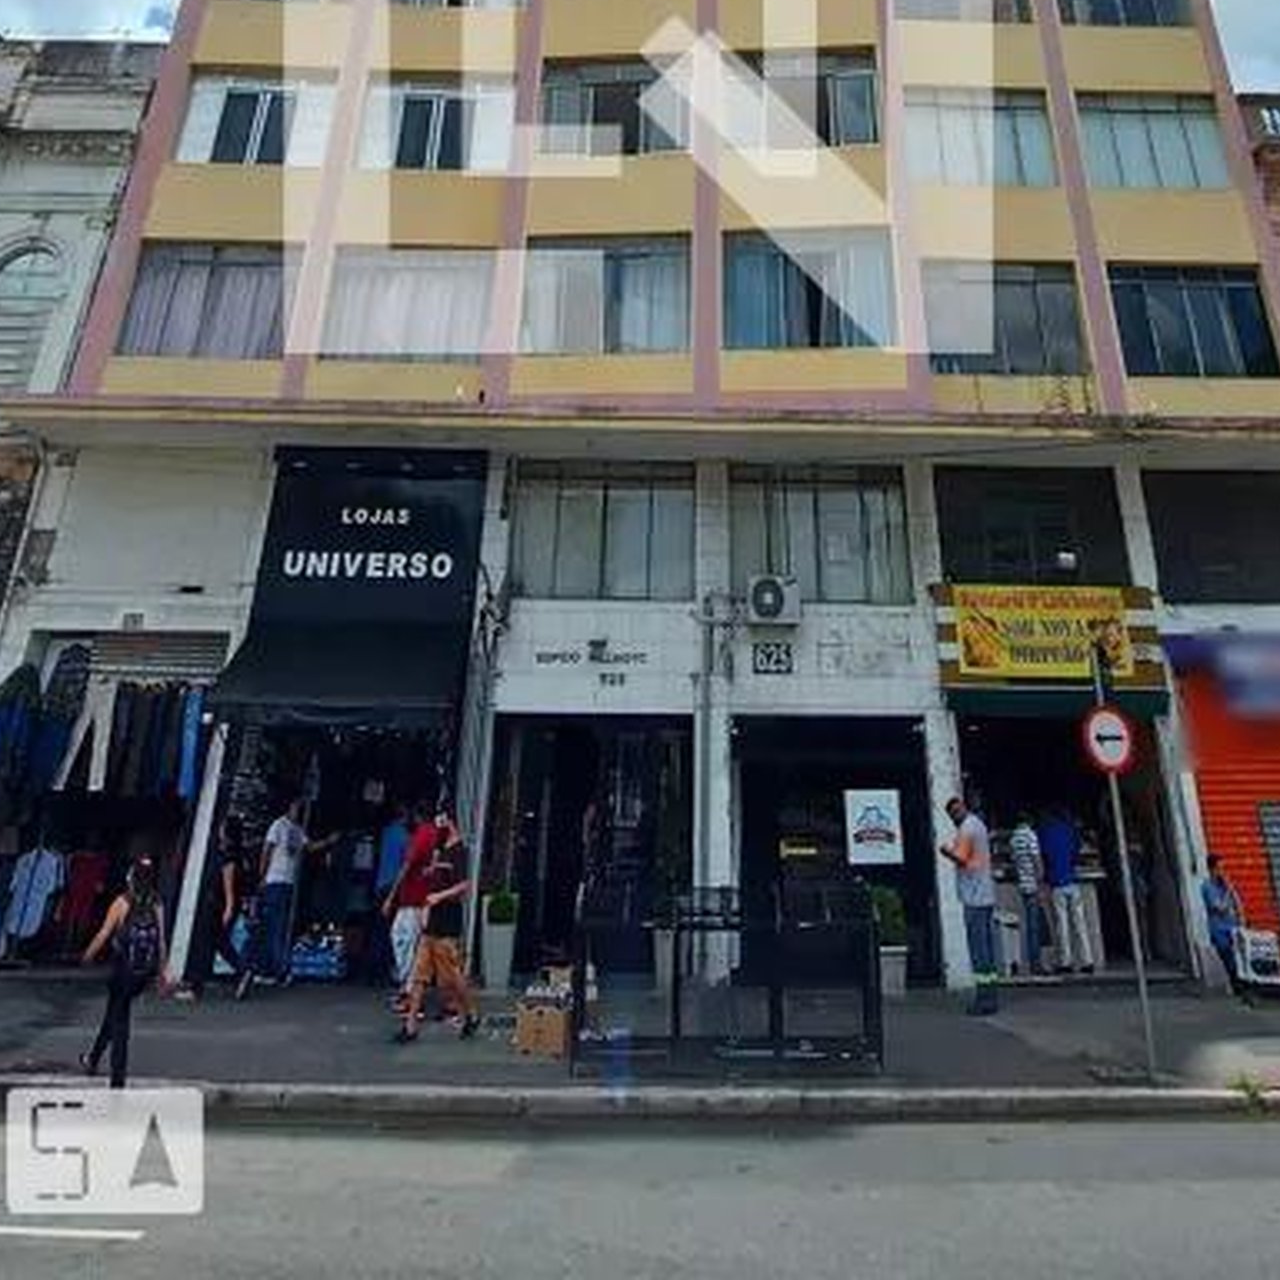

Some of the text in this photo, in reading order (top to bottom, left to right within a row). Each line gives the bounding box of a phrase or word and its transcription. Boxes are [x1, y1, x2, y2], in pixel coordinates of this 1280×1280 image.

[341, 507, 411, 525] LOJAS
[283, 550, 453, 579] UNIVERSO
[755, 644, 793, 671] 625
